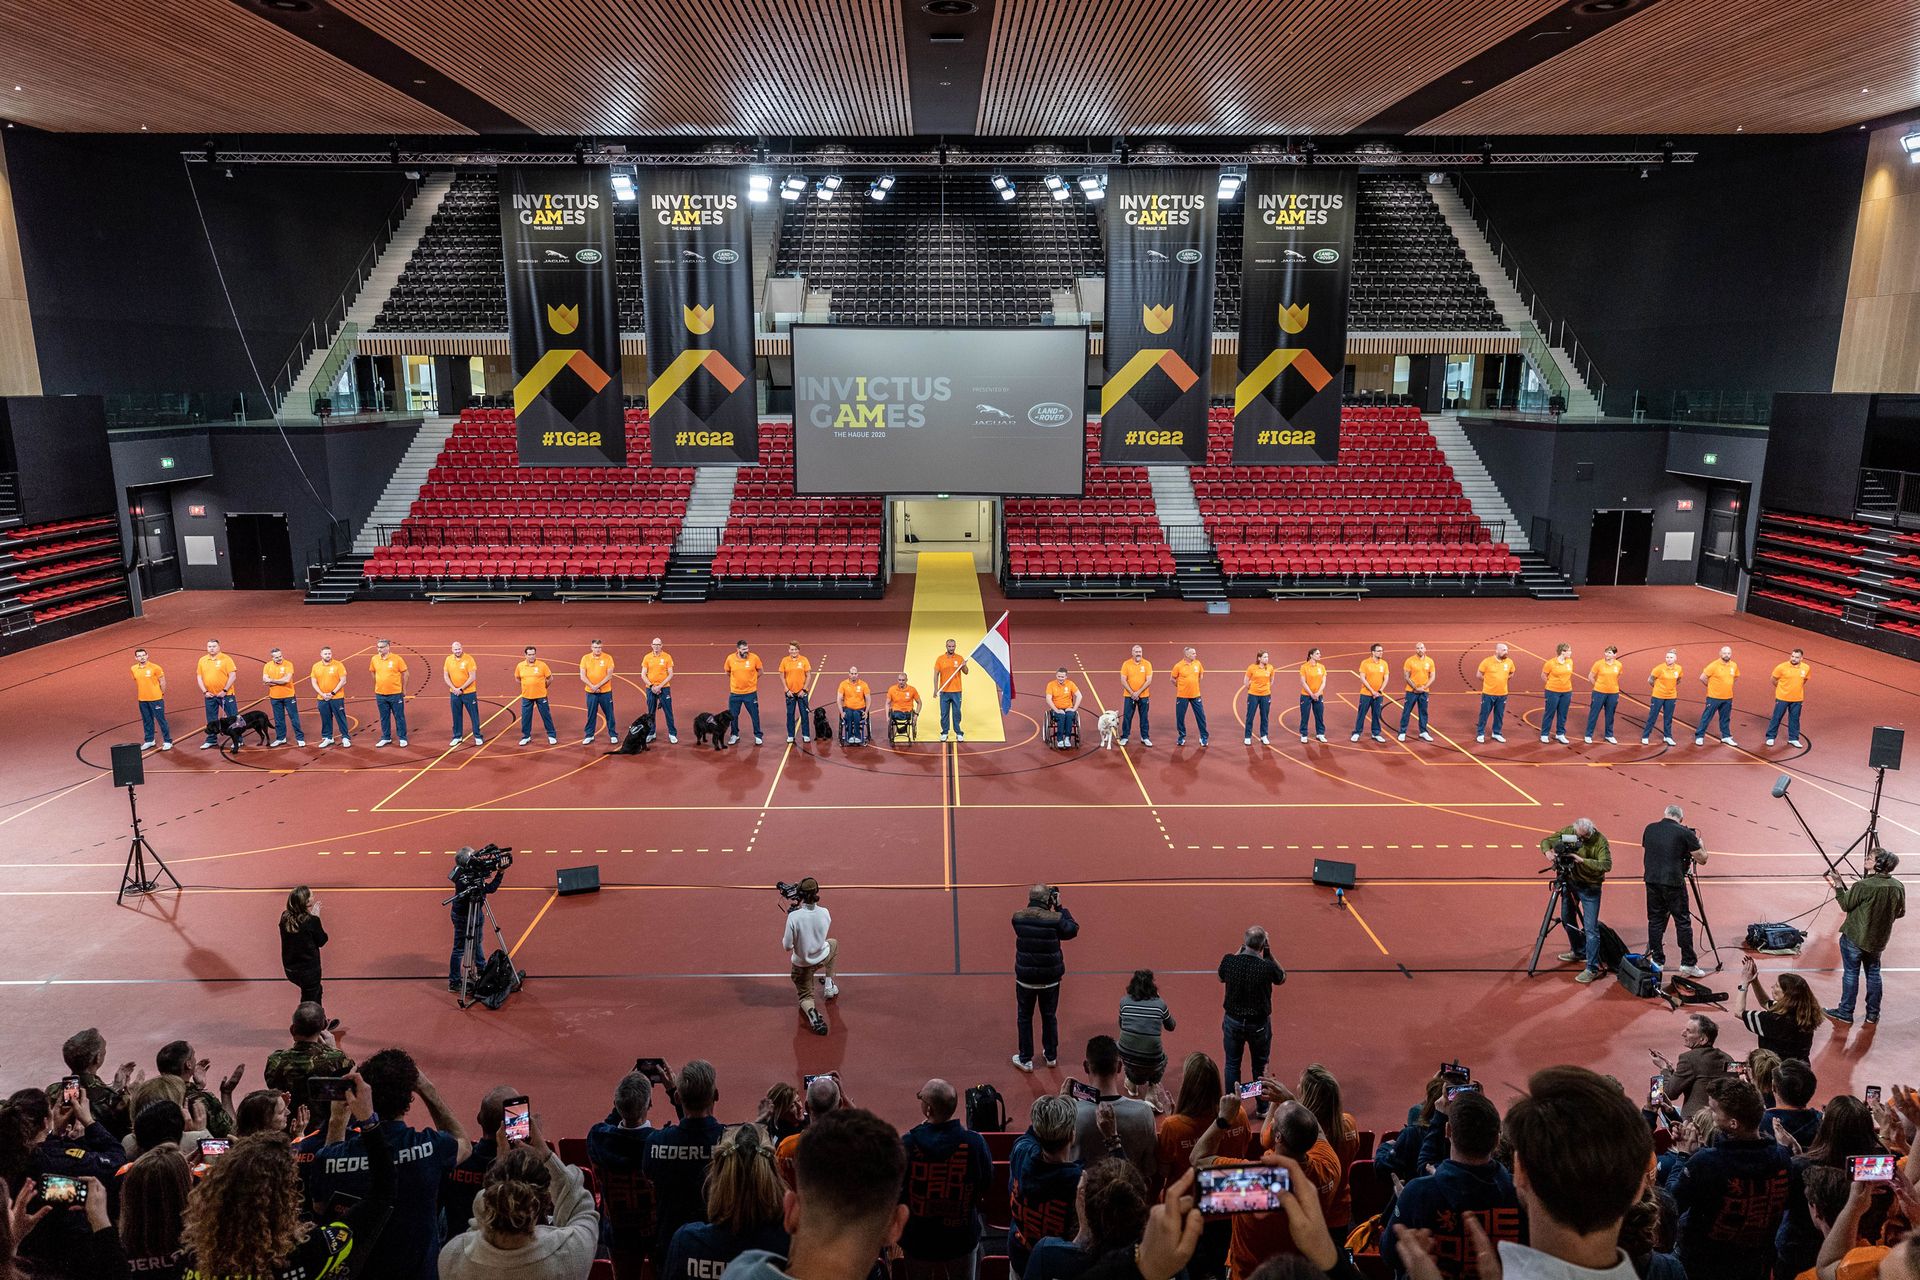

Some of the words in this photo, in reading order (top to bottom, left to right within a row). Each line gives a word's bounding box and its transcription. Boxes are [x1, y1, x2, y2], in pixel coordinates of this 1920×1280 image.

[512, 194, 599, 210] INVICTUS
[651, 194, 737, 210] INVICTUS
[1120, 194, 1205, 210] INVICTUS
[1258, 194, 1343, 209] INVICTUS
[520, 209, 586, 225] GAMES
[658, 210, 724, 225] GAMES
[1125, 210, 1190, 225] GAMES
[1263, 209, 1328, 225] GAMES
[800, 376, 952, 402] INVICTUS
[810, 403, 926, 428] GAMES
[542, 431, 602, 446] #IG22
[675, 431, 734, 446] #IG22
[1125, 430, 1184, 445] #IG22
[1257, 430, 1316, 445] #IG22
[650, 1144, 715, 1160] NEDERL
